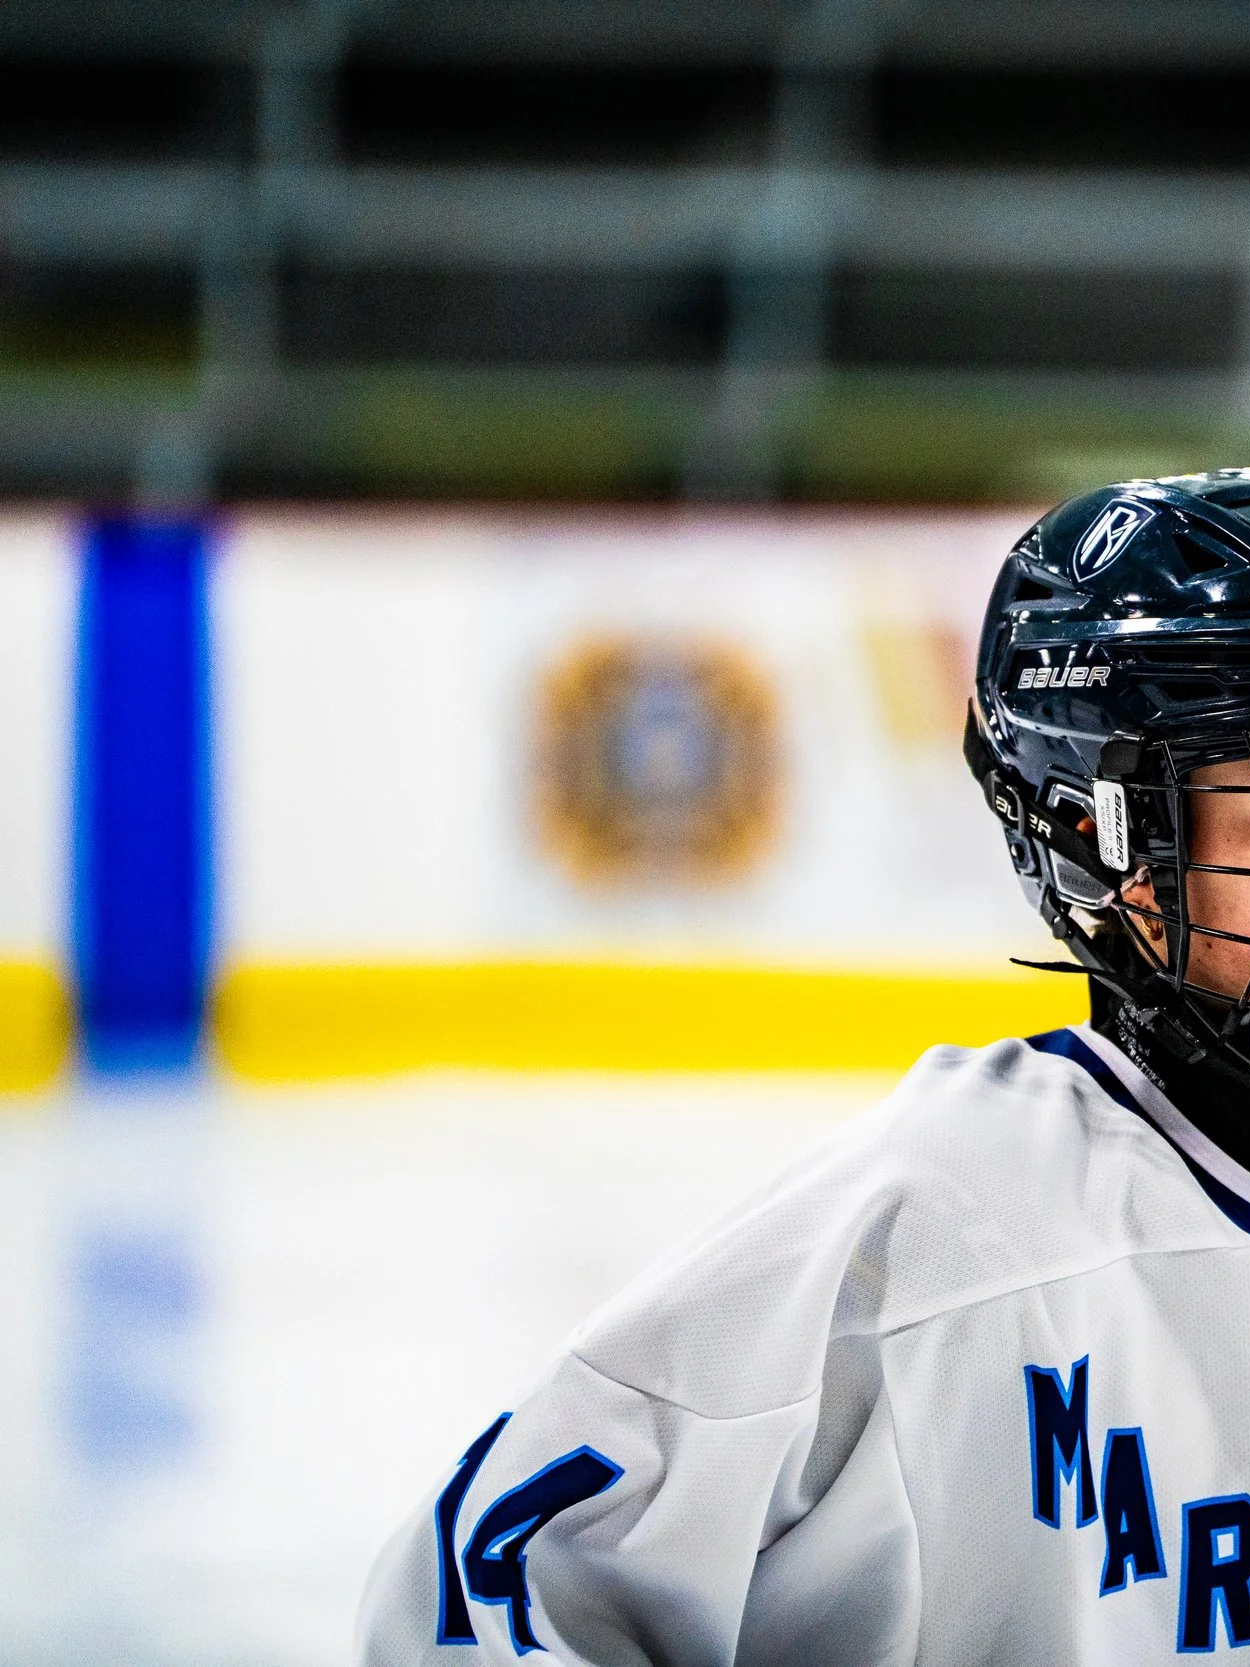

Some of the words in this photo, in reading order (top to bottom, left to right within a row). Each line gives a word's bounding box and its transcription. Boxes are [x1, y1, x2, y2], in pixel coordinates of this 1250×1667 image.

[1017, 666, 1111, 689] BAUER
[1114, 792, 1124, 864] BAUER
[434, 1411, 626, 1658] 14
